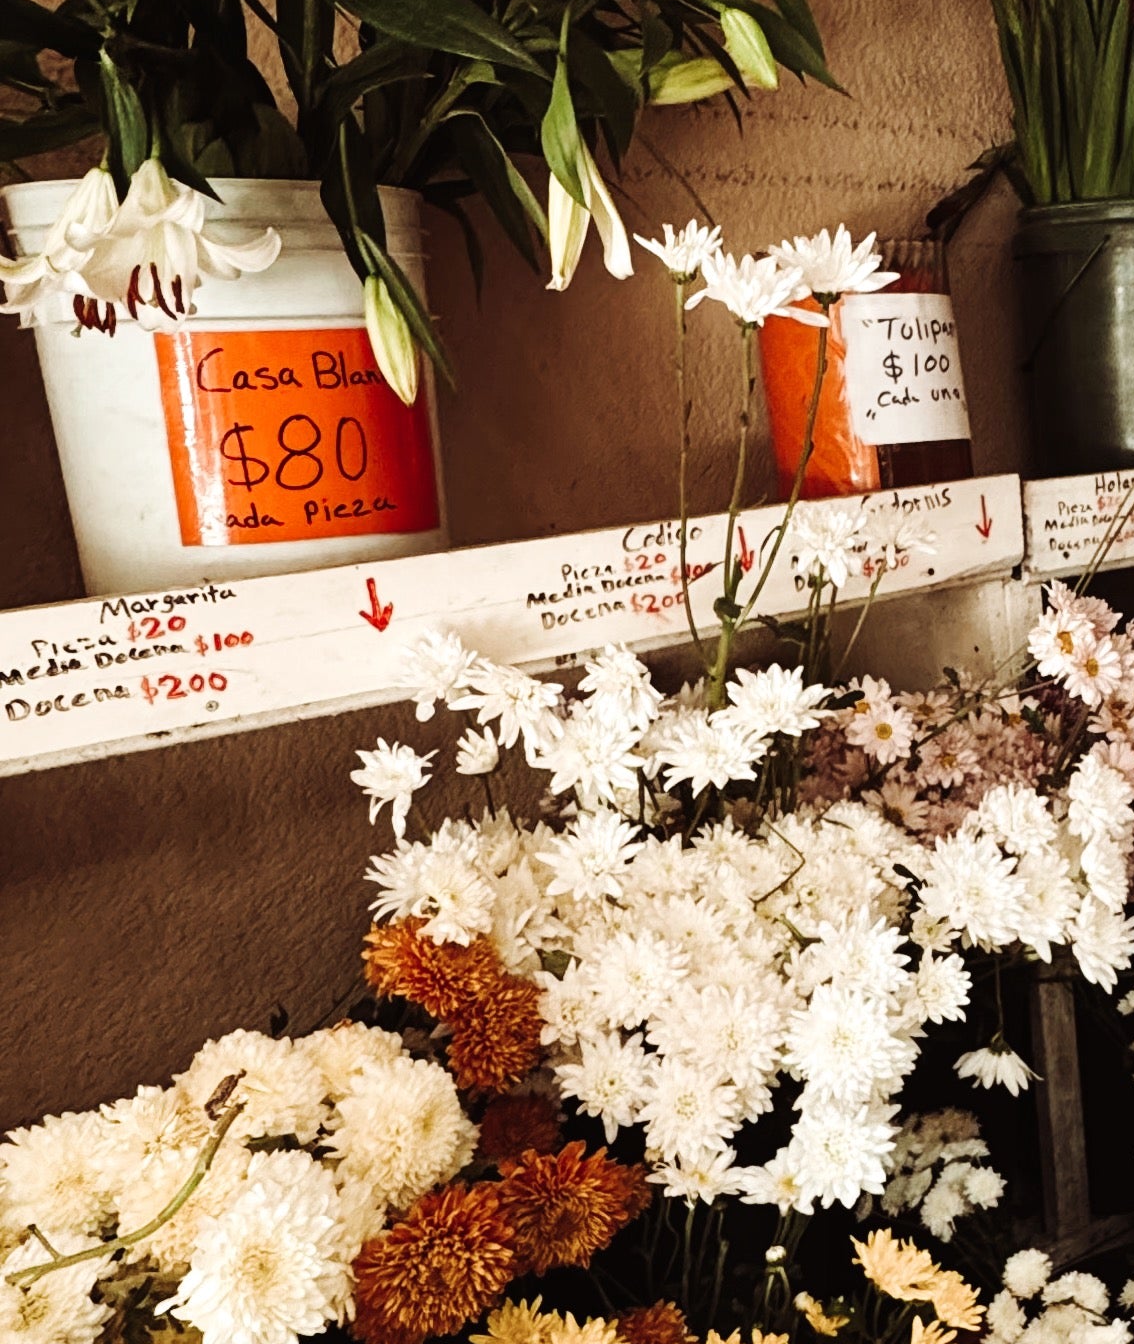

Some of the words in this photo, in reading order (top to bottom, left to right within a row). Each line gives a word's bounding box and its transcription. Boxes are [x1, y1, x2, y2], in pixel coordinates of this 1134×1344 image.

[196, 347, 303, 393] Casa
[311, 350, 386, 389] Blan
[882, 350, 950, 384] $100
[877, 387, 920, 407] Cada
[220, 414, 367, 492] $80
[212, 502, 285, 529] ada
[303, 495, 399, 525] Pieza
[1044, 515, 1089, 531] Media
[1058, 500, 1093, 516] Pieza
[561, 563, 616, 582] Pieza
[624, 553, 667, 573] $20
[99, 585, 237, 624] Margarita
[526, 582, 597, 609] Media
[601, 573, 666, 593] Docena
[540, 599, 627, 631] Docena
[31, 635, 118, 658] Pieza
[127, 615, 187, 643] $20
[0, 658, 88, 689] Media
[94, 643, 190, 669] Docena
[194, 631, 254, 657] $100
[5, 684, 132, 722] Docena
[140, 672, 228, 705] $200
